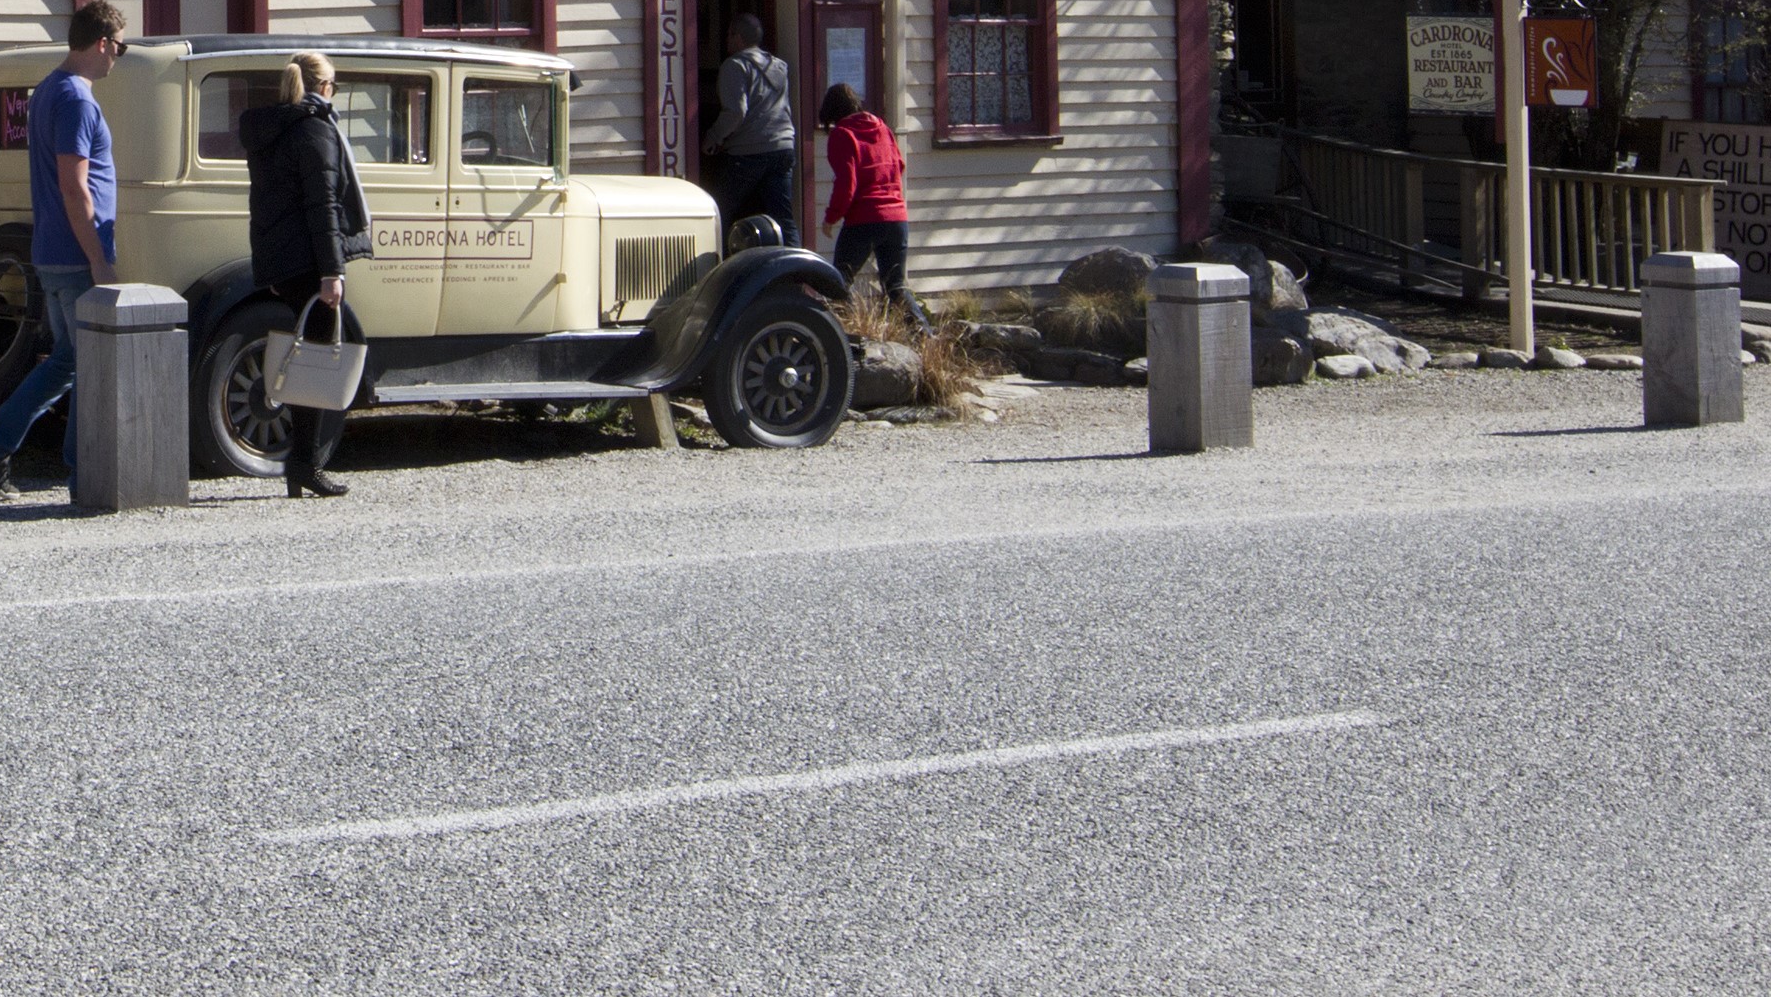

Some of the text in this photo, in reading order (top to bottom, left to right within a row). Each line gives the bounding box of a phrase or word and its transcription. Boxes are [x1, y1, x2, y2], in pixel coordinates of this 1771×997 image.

[1410, 24, 1494, 52] CARDRONA
[1450, 50, 1473, 59] 1865
[1413, 59, 1494, 74] RESTAURANT
[1426, 75, 1482, 89] AND BAR
[1669, 132, 1689, 153] IF
[1699, 132, 1749, 157] YOU
[1676, 158, 1691, 178] A
[378, 230, 525, 246] CARDRONA HOTEL
